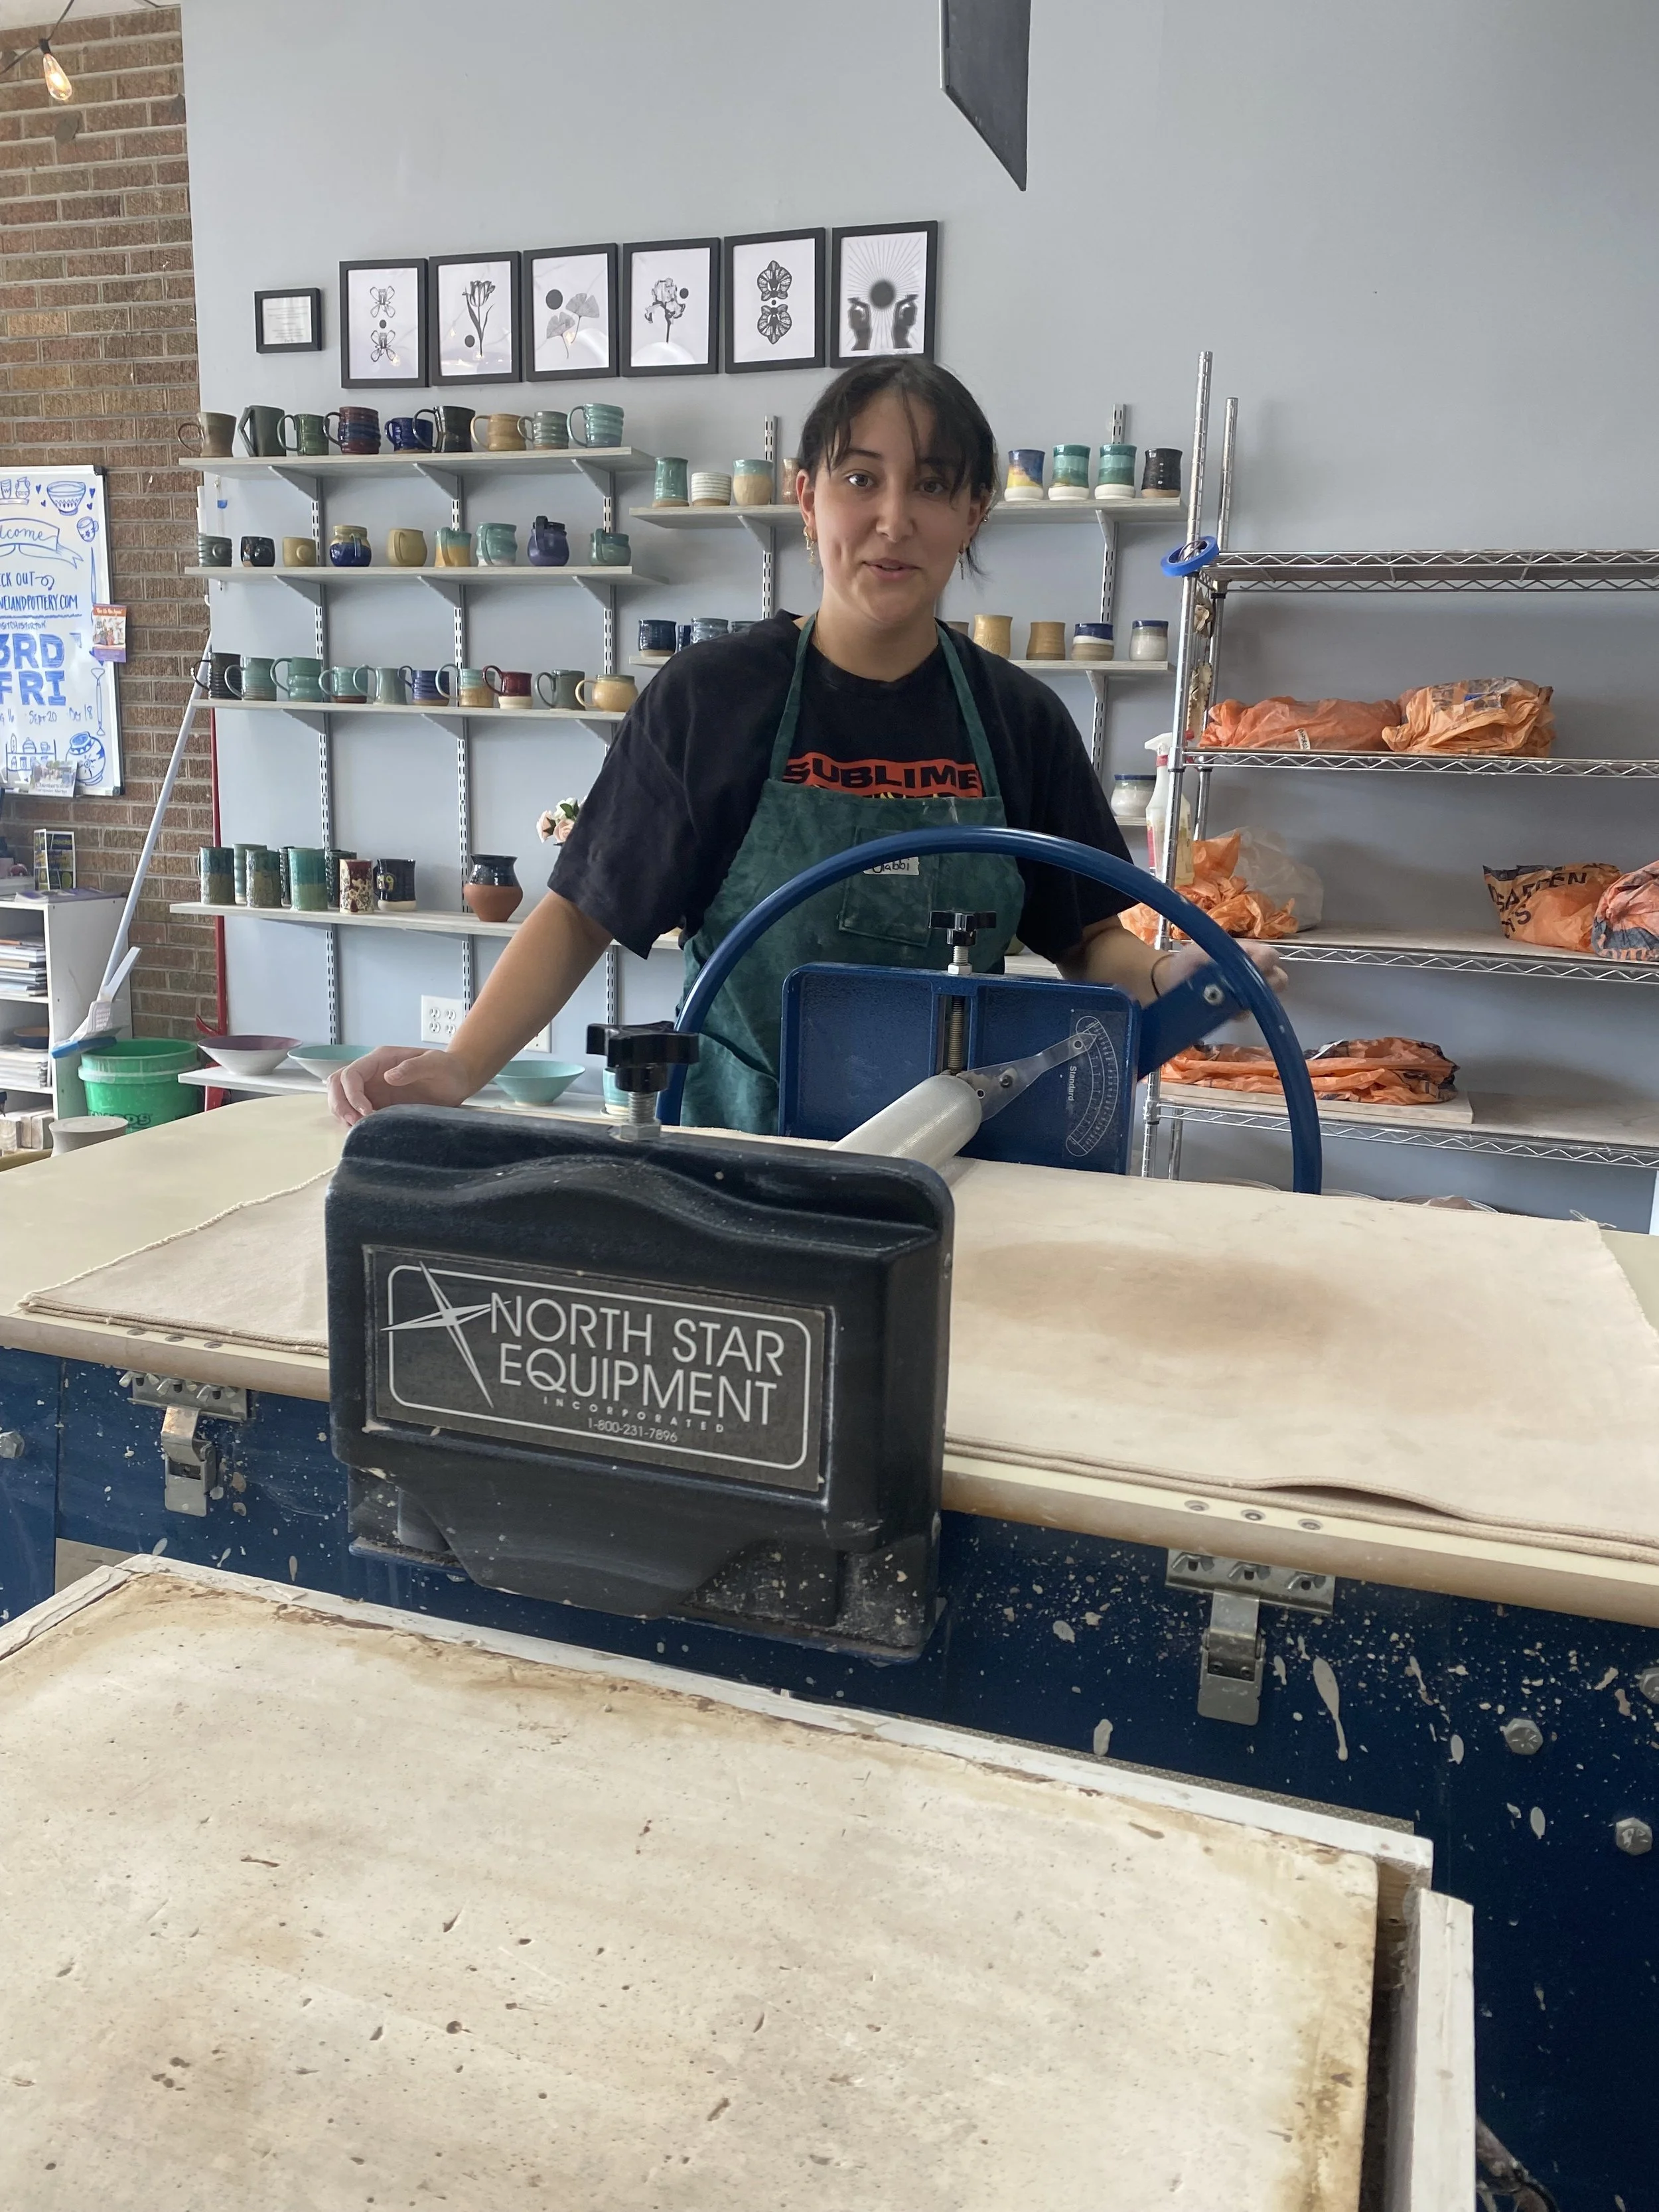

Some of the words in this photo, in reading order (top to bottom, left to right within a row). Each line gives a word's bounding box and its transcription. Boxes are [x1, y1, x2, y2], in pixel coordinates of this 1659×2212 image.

[16, 571, 35, 587] OUT
[782, 758, 979, 788] SUBLIME
[1068, 1065, 1077, 1101] Standard
[490, 1291, 652, 1357] NORTH
[672, 1317, 784, 1376] STAR
[500, 1342, 778, 1426] EQUIPMENT
[543, 1396, 724, 1434] INCORPORATED
[587, 1417, 678, 1443] 1-800-231-7896
